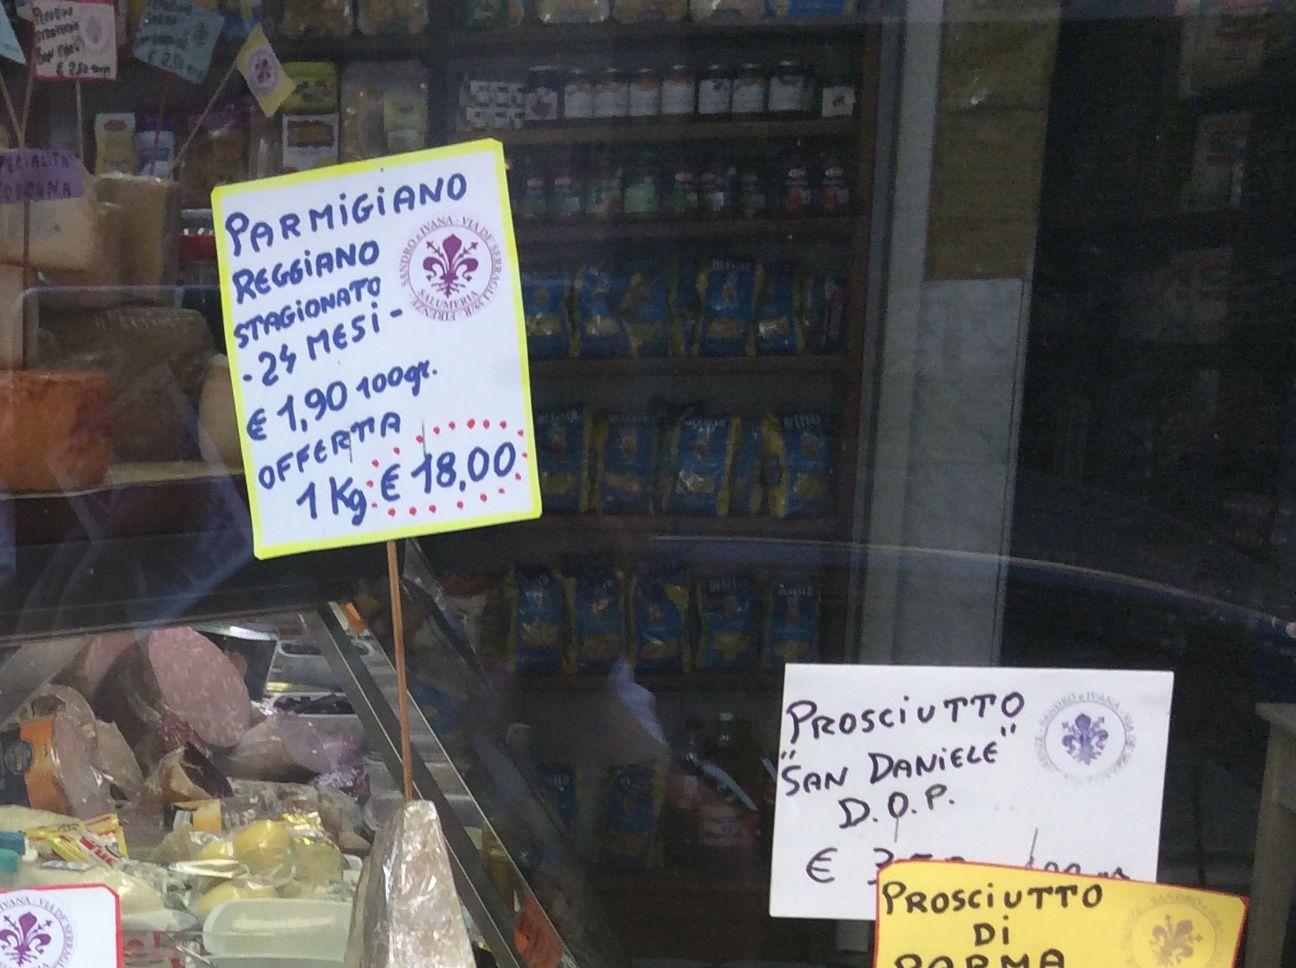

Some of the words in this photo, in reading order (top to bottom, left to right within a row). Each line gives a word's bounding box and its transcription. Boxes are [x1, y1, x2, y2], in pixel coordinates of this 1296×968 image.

[225, 173, 467, 257] PARMIGIANO
[232, 240, 380, 304] REGGIANO
[233, 276, 381, 348] STAGIONATO
[246, 408, 267, 441] €
[276, 381, 348, 432] 1,90
[258, 412, 401, 490] OFFERTA
[329, 476, 367, 527] Kg
[380, 464, 401, 501] €
[410, 441, 517, 494] 18,00
[786, 691, 1025, 744] PROSCIUTTO
[838, 784, 955, 829] D.O.P.
[805, 847, 838, 884] €
[881, 881, 1104, 915] PROSCIUTTO
[973, 915, 1009, 947] DI
